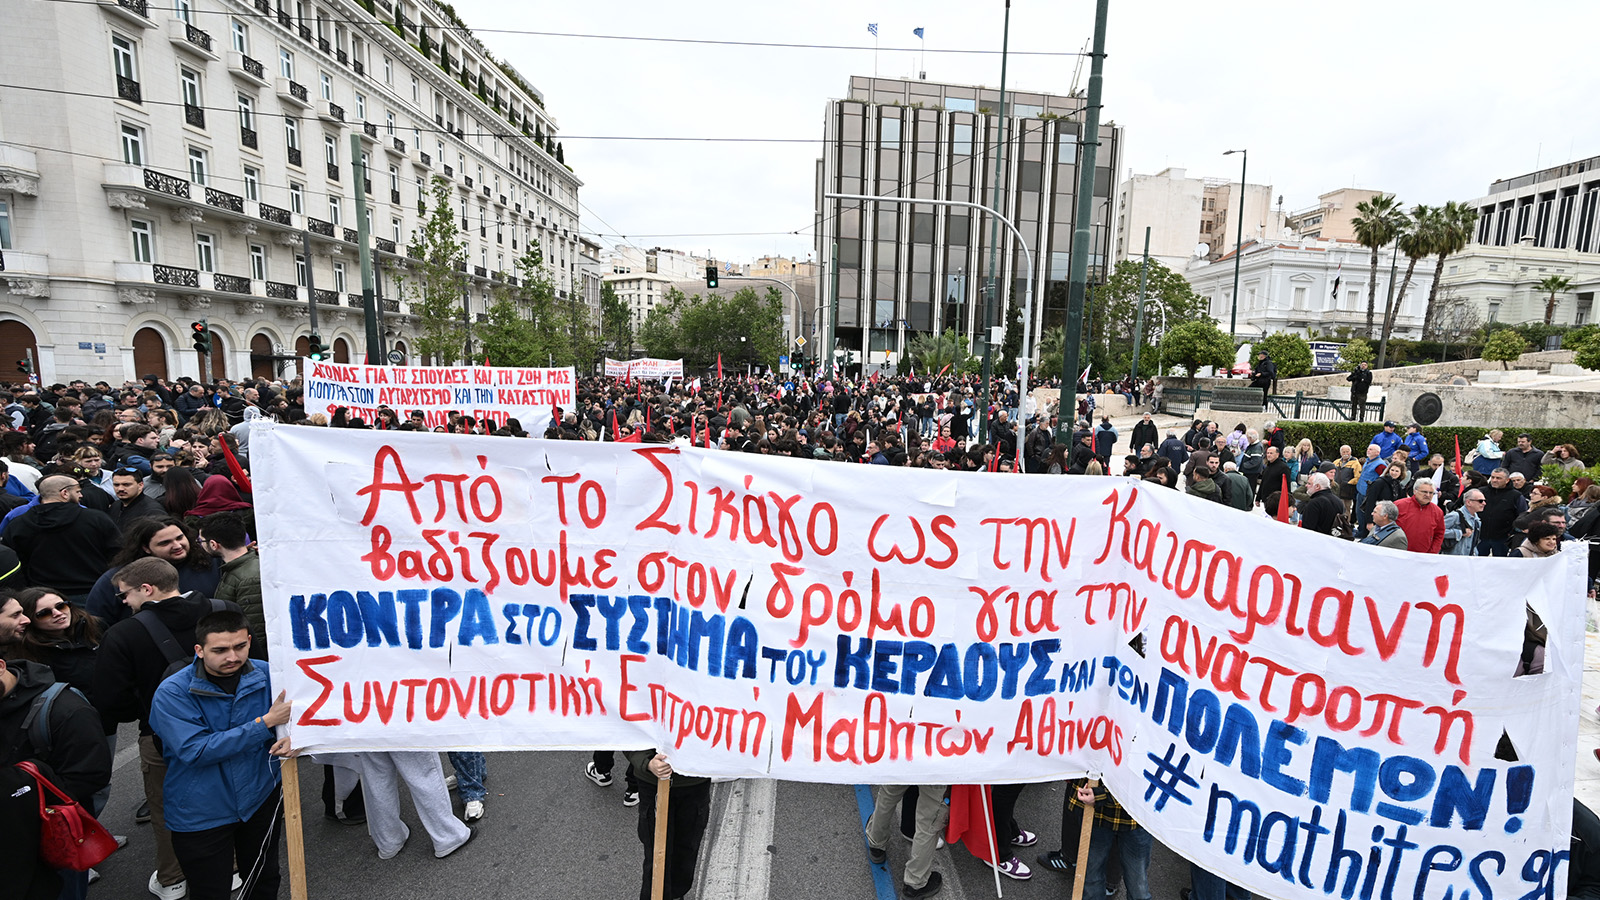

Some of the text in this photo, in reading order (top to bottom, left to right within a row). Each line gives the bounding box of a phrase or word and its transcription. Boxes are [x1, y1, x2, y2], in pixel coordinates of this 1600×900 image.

[365, 367, 388, 384] ΓΙΑ
[392, 368, 407, 384] ΤΙΣ
[411, 368, 469, 384] ΣΠΟΥΔΕΣ
[474, 369, 492, 385] ΚΑΙ
[497, 370, 513, 385] ΤΗ
[517, 370, 541, 385] ΖΩΗ
[547, 370, 570, 384] ΜΑΣ
[378, 387, 451, 405] ΑΥΤΑΡΧΙΣΜΟ
[455, 388, 471, 404] ΚΑΙ
[475, 388, 493, 404] ΤΗΝ
[498, 389, 570, 405] ΚΑΤΑΣΤΟΛΗ
[356, 444, 1465, 685] Από το Σικάγο ως την Καισαριανή
[360, 524, 1476, 766] βαδίζουμε στον δρόμο για την ανατροπή
[288, 587, 1535, 835] ΚΟΝΤΡΑ ΣΤΟ ΣΥΣΤΗΜΑ ΤΟΥ ΚΕΡΔΟΥΣ ΚΑΙ ΤΩΝ ΠΟΛΕΜΩΝ!
[295, 654, 1123, 767] Συντονιστική Επτροπή Μαθητών Αθήνας
